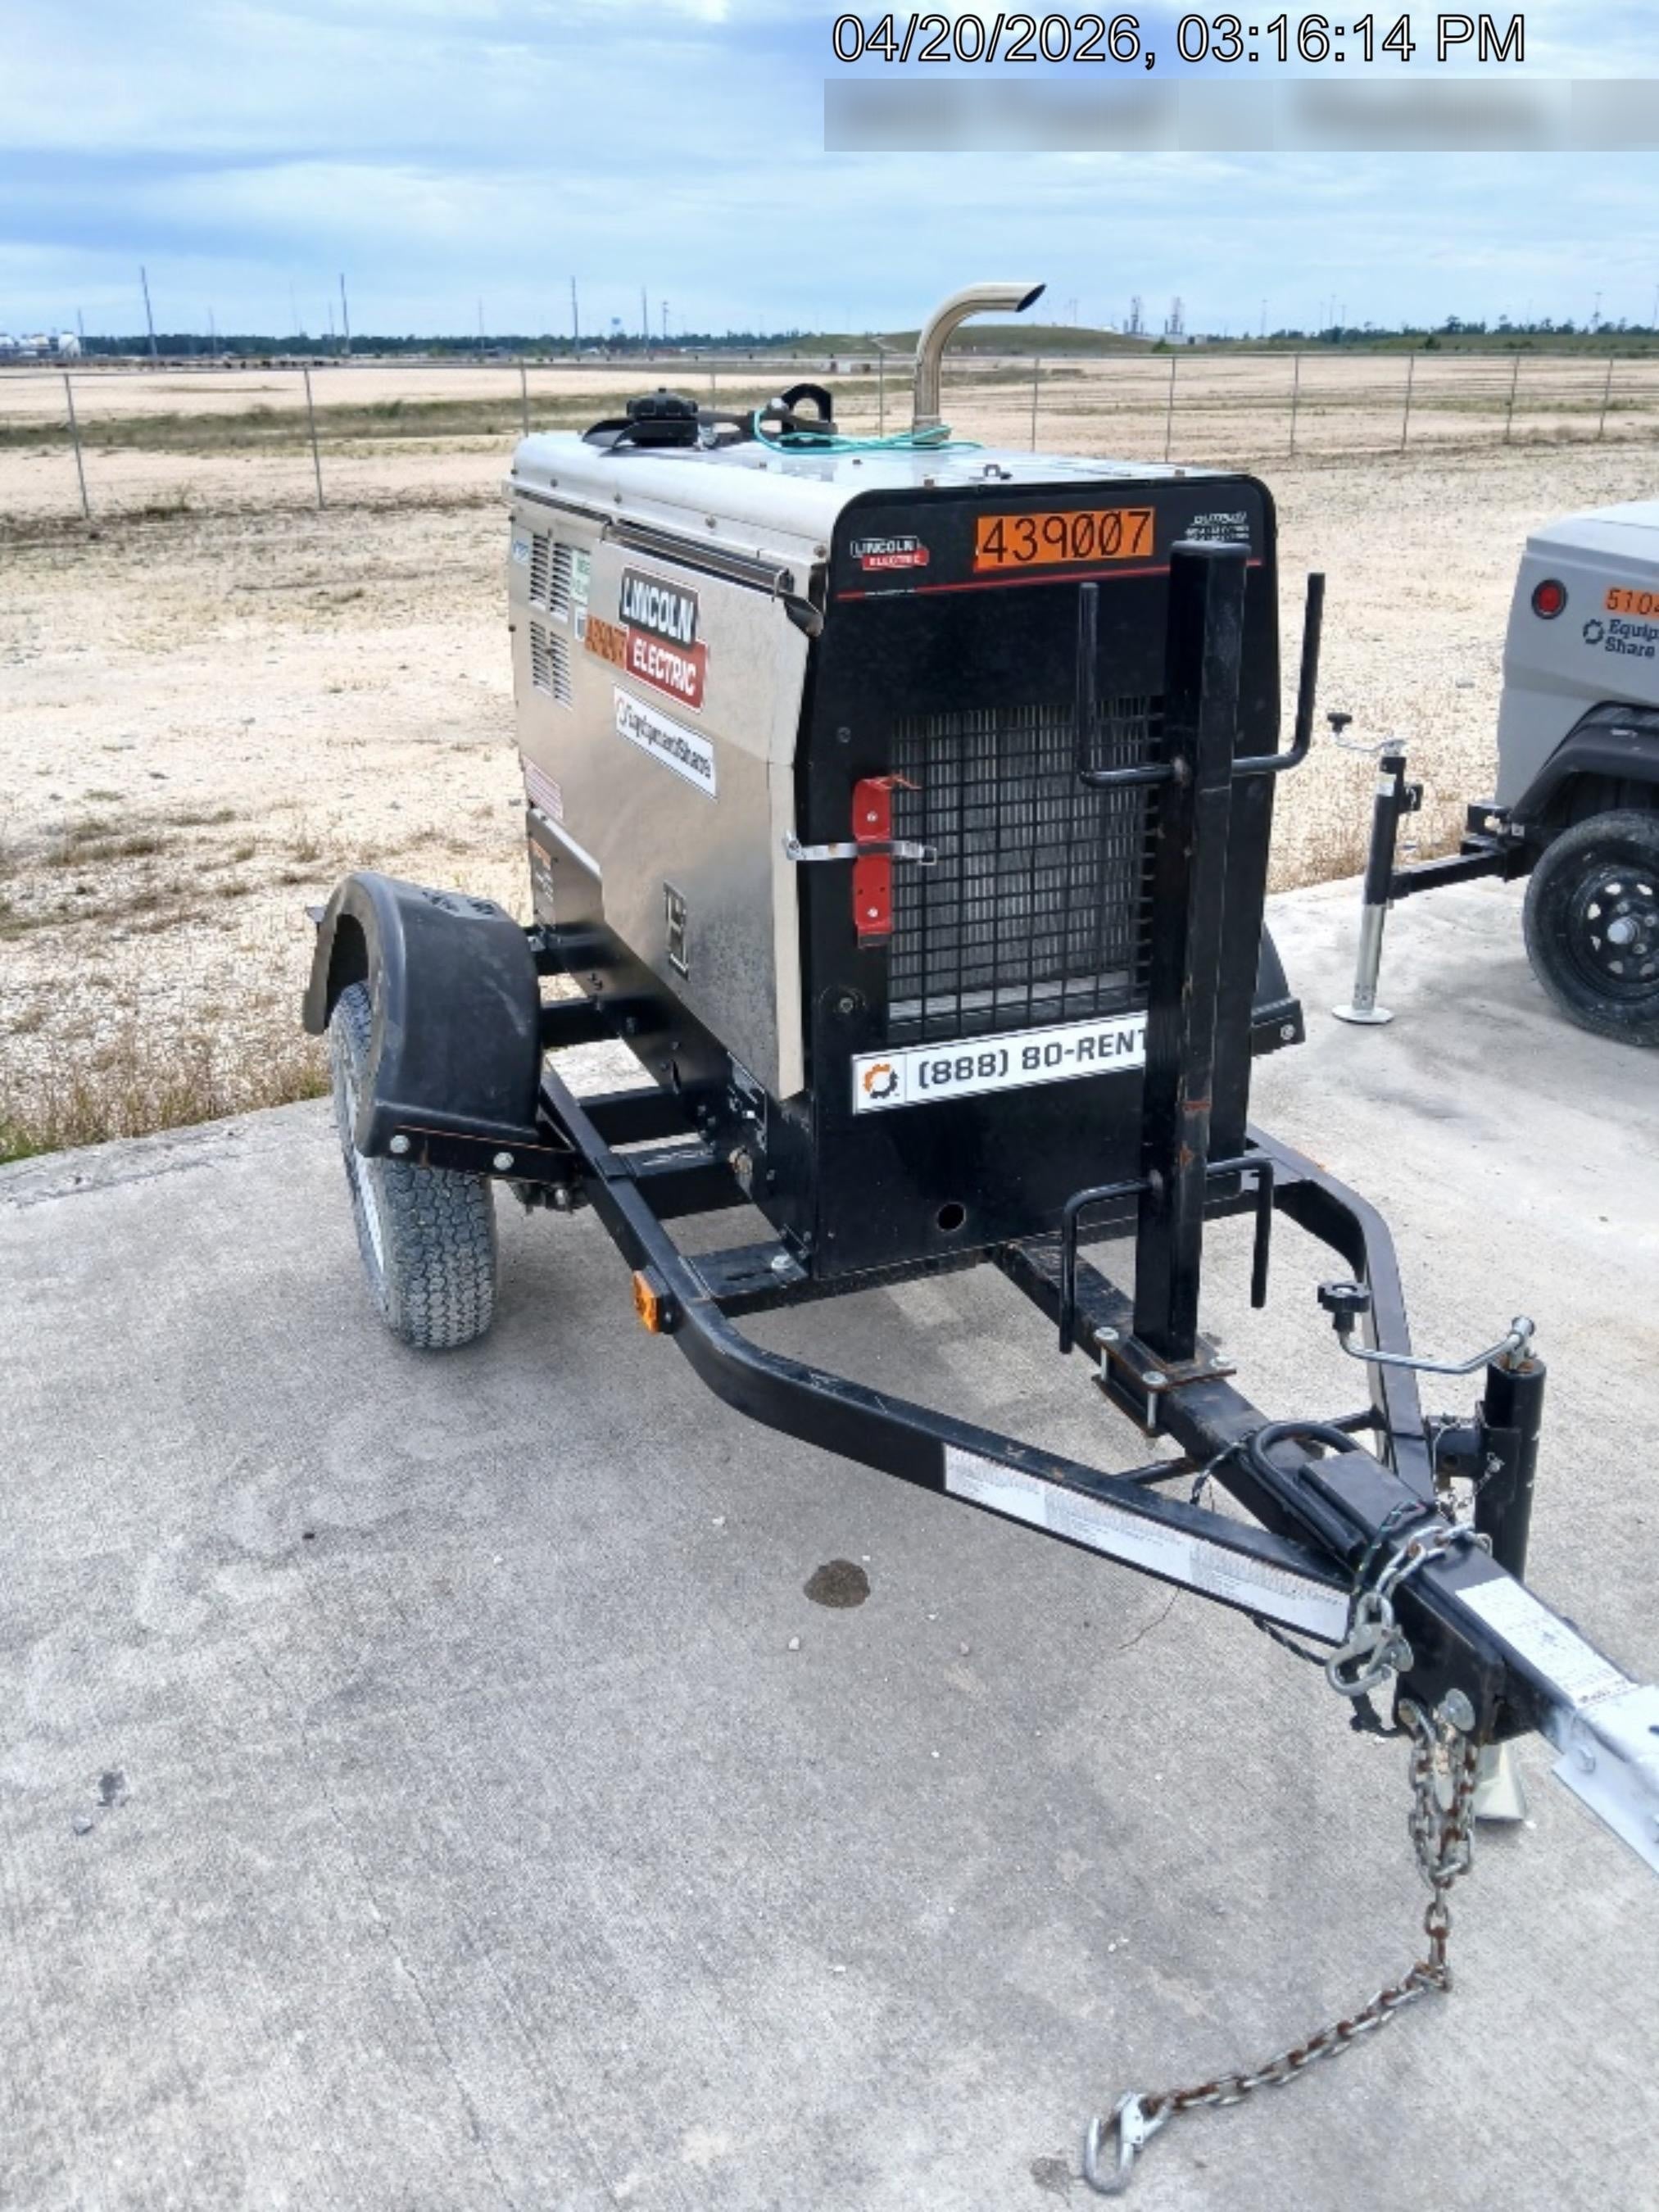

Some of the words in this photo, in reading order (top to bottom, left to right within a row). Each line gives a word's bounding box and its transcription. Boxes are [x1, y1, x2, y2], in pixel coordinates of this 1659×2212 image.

[854, 539, 916, 555] LINCOLN
[982, 510, 1152, 564] 439007
[622, 577, 696, 644] LINCOLN
[1609, 619, 1659, 641] Equip
[1605, 636, 1655, 658] Share
[632, 638, 696, 696] ELECTRIC
[918, 1049, 1009, 1088] (888)
